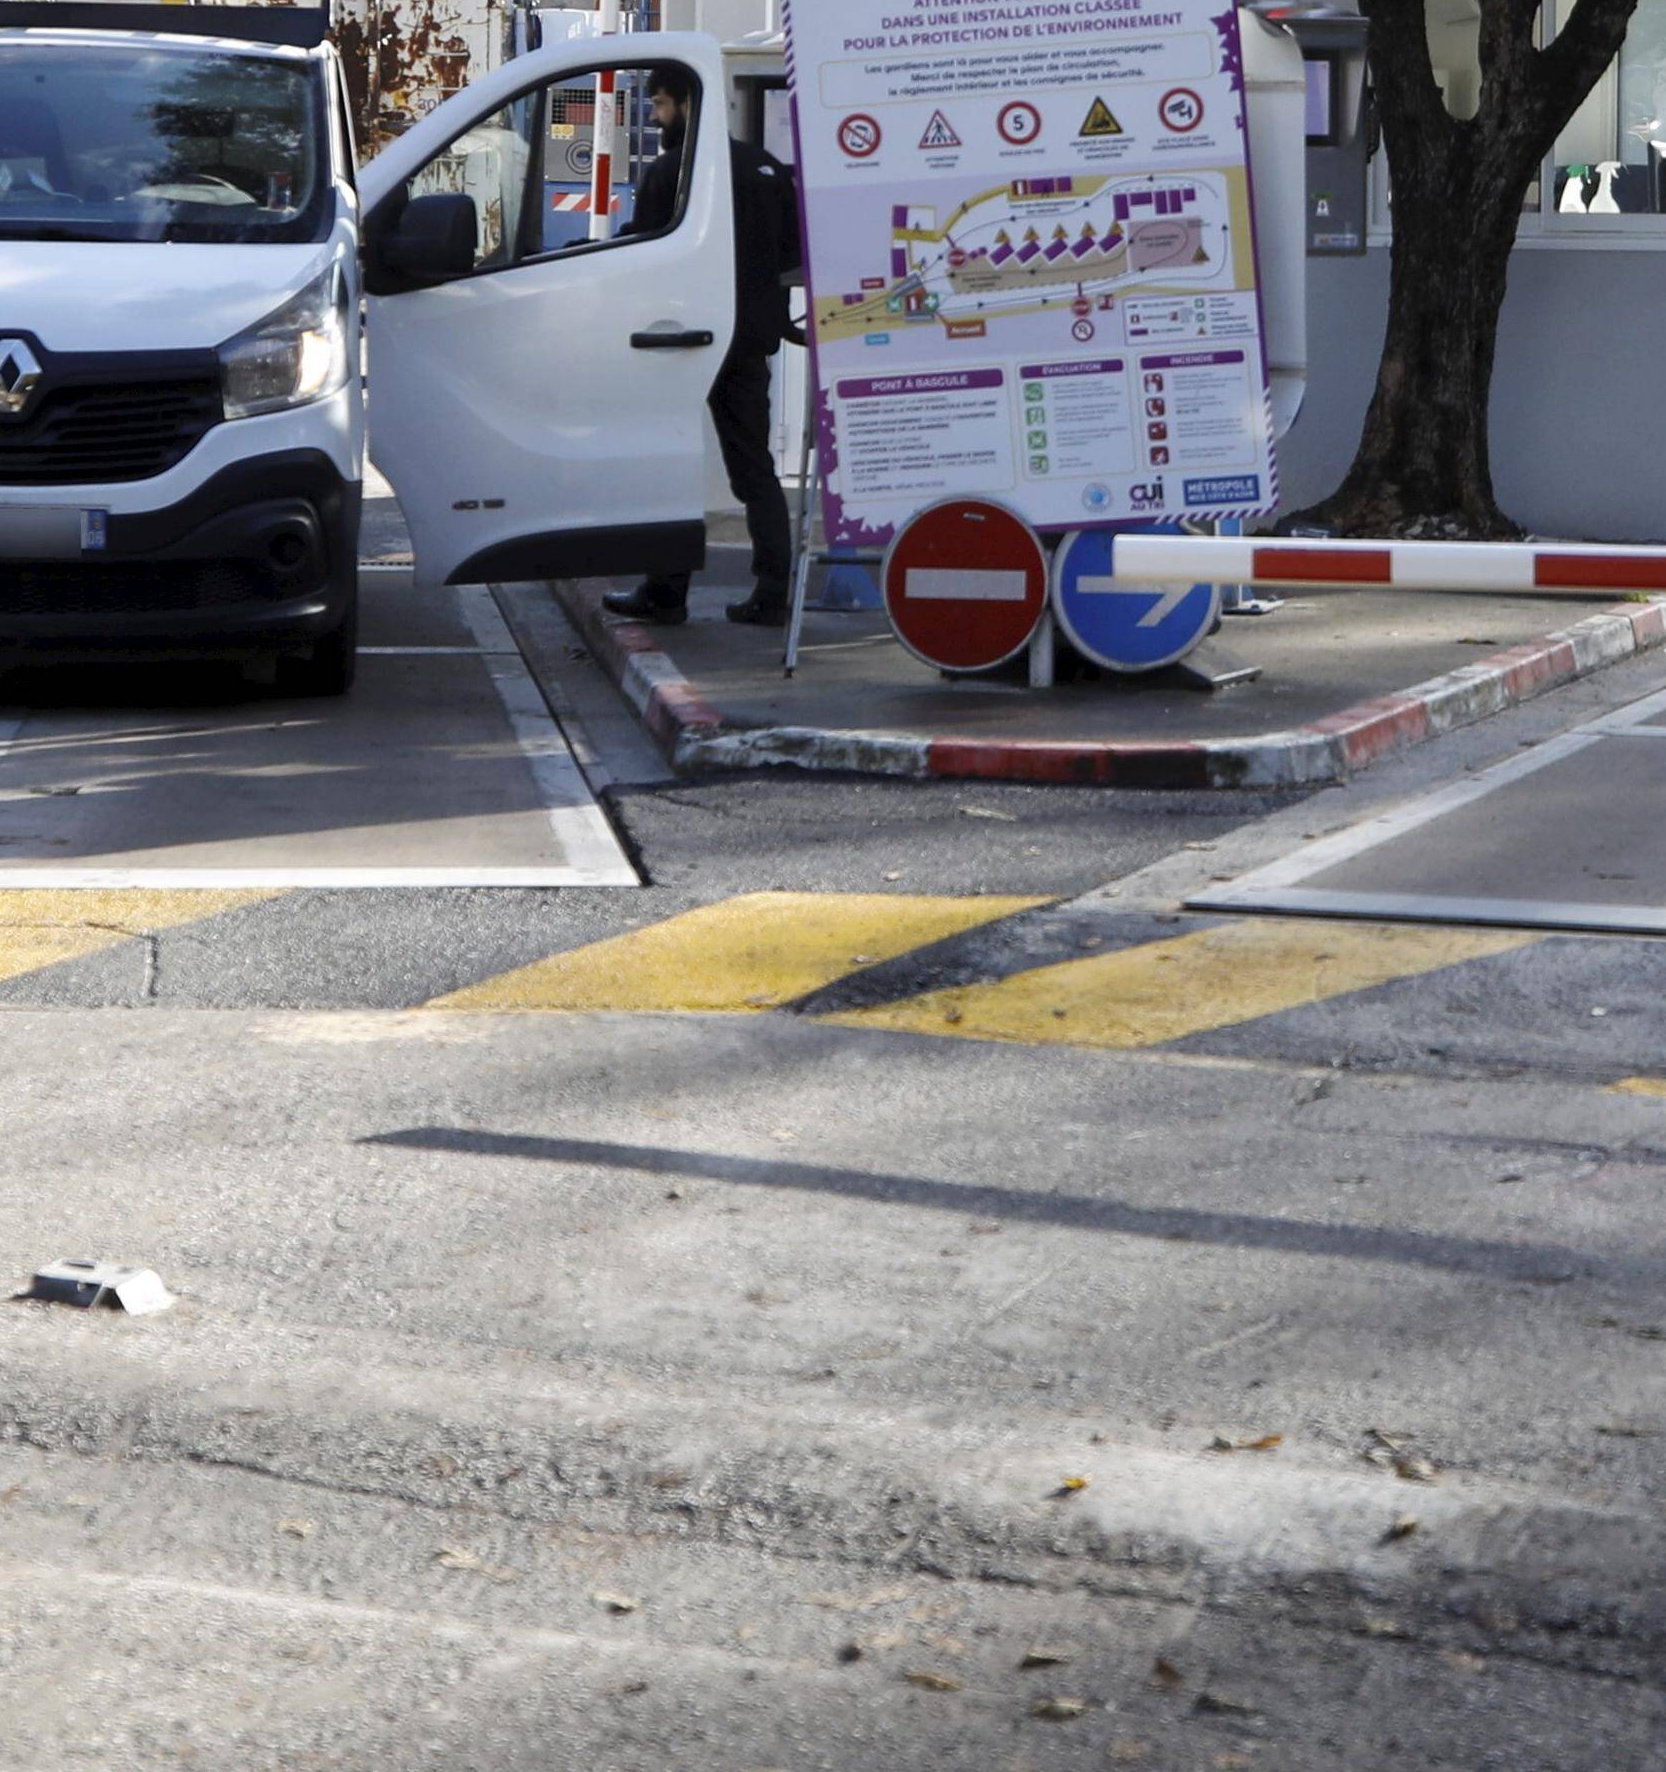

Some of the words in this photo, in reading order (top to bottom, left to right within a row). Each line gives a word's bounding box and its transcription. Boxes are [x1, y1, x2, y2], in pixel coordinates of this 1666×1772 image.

[881, 15, 924, 30] DANS
[927, 12, 958, 27] UNE
[962, 3, 1071, 24] INSTALLATION
[843, 35, 886, 51] POUR
[889, 33, 908, 48] LA
[911, 26, 1009, 46] PROTECTION
[1012, 23, 1033, 38] DE
[1036, 12, 1183, 37] L'ENVIRONNEMENT
[864, 64, 882, 74] Les
[884, 62, 930, 75] gardiens
[932, 59, 955, 69] sont
[969, 56, 993, 68] pour
[995, 55, 1019, 64] vous
[1051, 50, 1061, 58] et
[1063, 49, 1086, 57] vous
[942, 70, 955, 80] de
[957, 67, 1007, 79] respecter
[1046, 61, 1059, 71] de
[1085, 71, 1098, 80] de
[1013, 115, 1025, 130] 5
[871, 380, 903, 391] PONT
[915, 374, 968, 388] BASCULE
[1188, 480, 1254, 493] MÉTROPOLE
